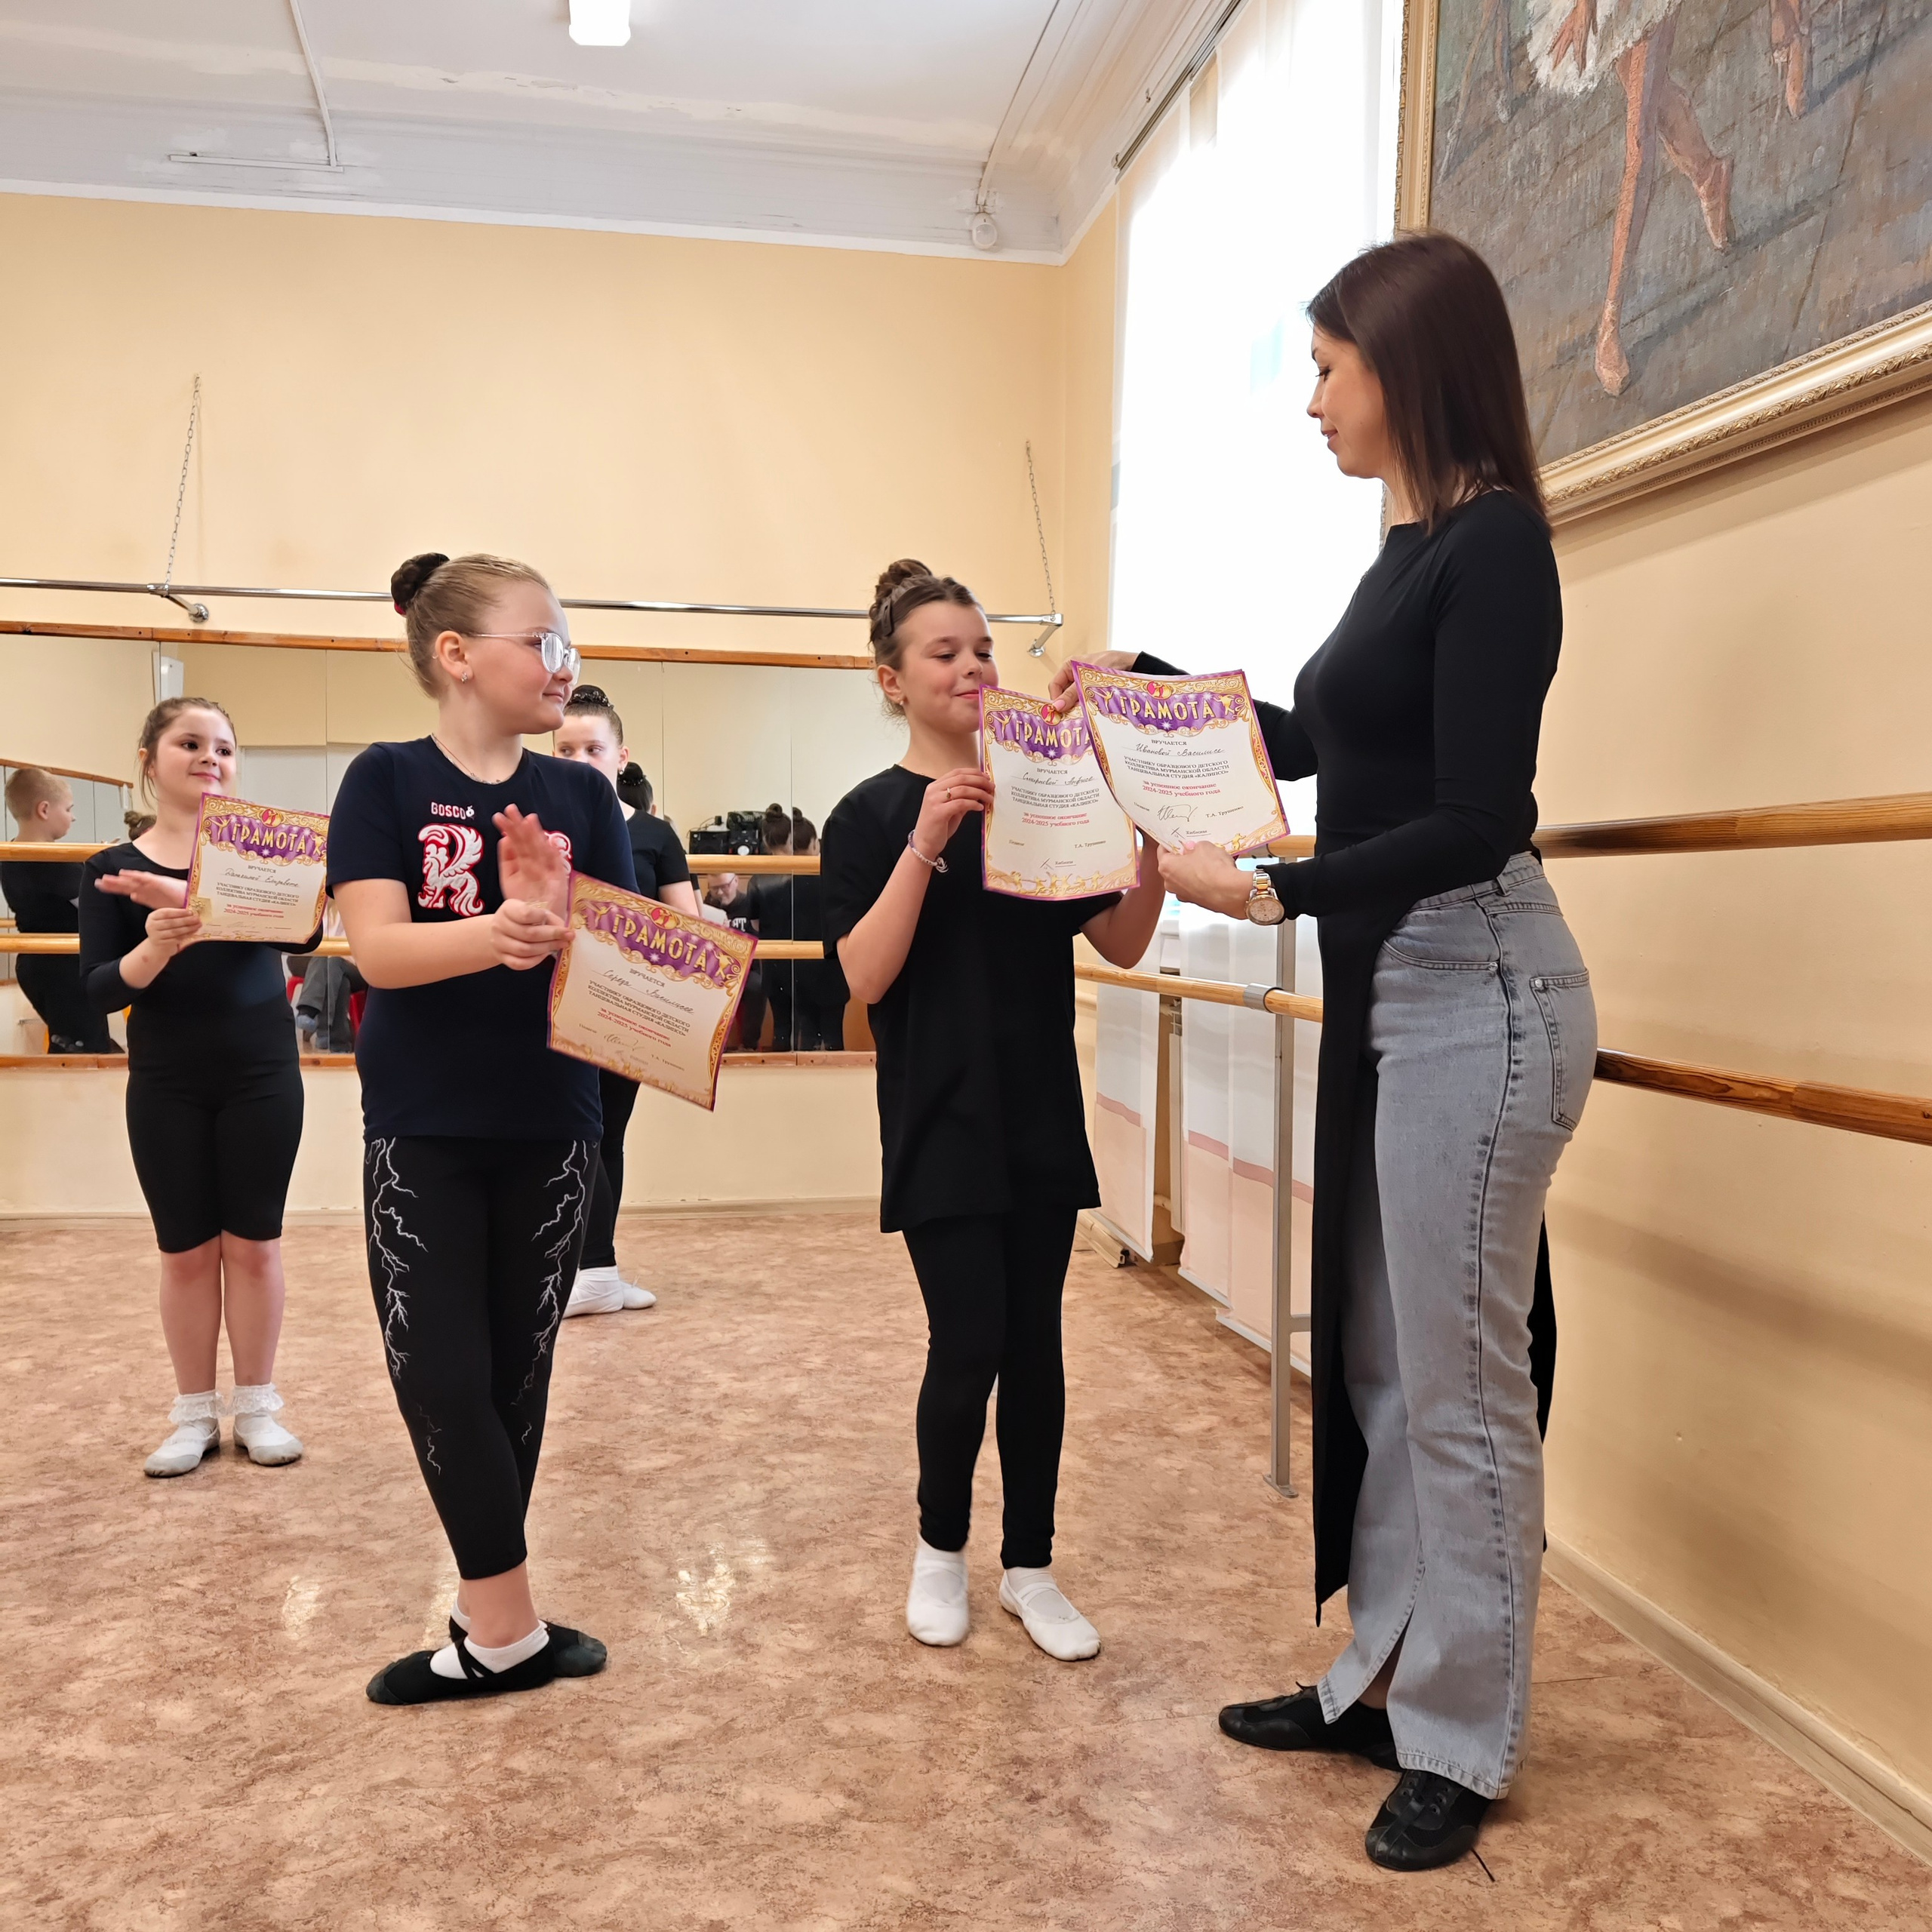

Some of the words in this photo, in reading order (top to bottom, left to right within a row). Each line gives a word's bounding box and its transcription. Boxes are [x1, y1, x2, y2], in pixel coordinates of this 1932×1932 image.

[1118, 696, 1216, 721] ГРАМОТА
[1135, 743, 1171, 755] Ивановой
[1177, 748, 1224, 756] Василисе
[1124, 755, 1155, 767] УЧАСТНИКУ
[1198, 760, 1228, 768] ДЕТСКОГО
[1124, 760, 1160, 772] КОЛЛЕКТИВА
[1128, 765, 1170, 778] ТАНЦЕВАЛЬНАЯ
[1195, 770, 1229, 778] «КАЛИПСО»
[1143, 786, 1173, 795] 2024-2025
[1150, 781, 1180, 790] успешное
[431, 801, 466, 820] BOSCO
[232, 823, 306, 854] ГРАМОТА
[611, 913, 708, 972] ГРАМОТА
